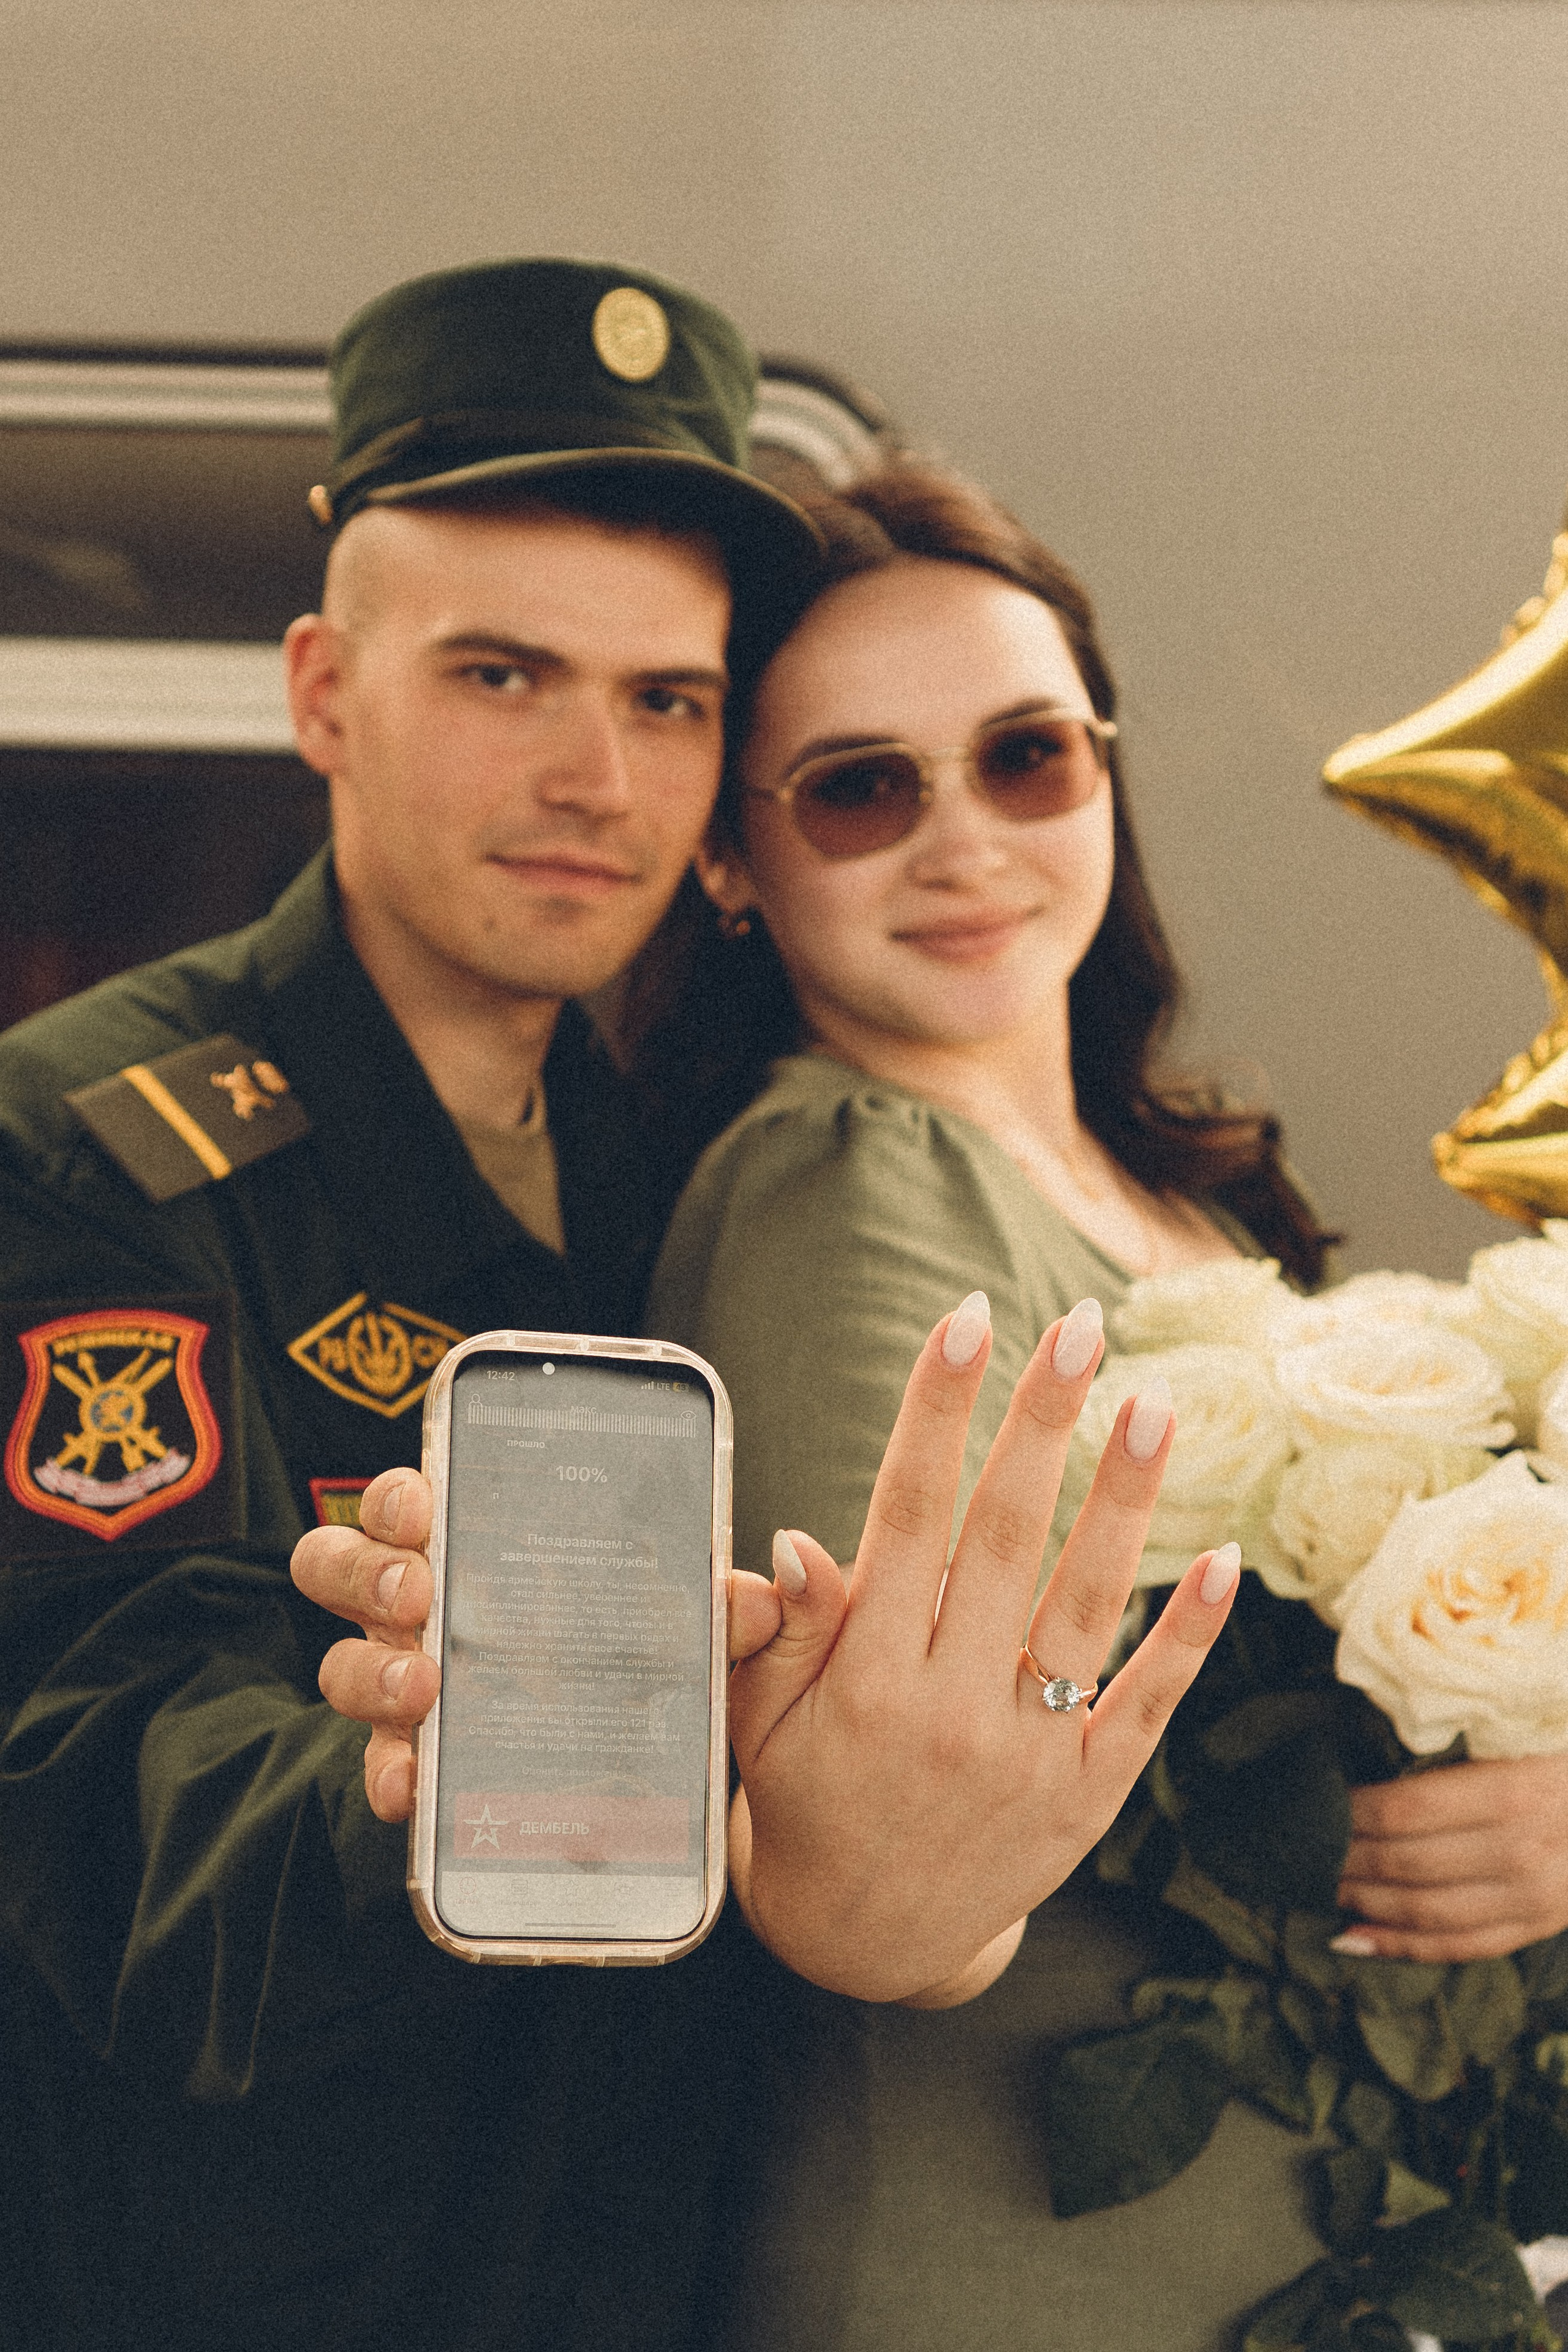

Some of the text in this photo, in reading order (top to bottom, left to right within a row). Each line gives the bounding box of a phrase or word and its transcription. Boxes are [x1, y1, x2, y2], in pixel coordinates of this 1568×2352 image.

[487, 1370, 515, 1381] 12:42
[657, 1382, 670, 1391] LTE
[507, 1439, 545, 1449] прошло
[556, 1465, 608, 1483] 100%
[527, 1534, 633, 1550] Поздравляем с
[500, 1551, 658, 1570] завершением службы!
[466, 1573, 505, 1585] Пройдя
[508, 1575, 567, 1588] армейскую
[584, 1594, 638, 1604] увереннее
[674, 1610, 692, 1618] все
[534, 1616, 575, 1627] нужные
[577, 1618, 595, 1628] для
[625, 1620, 656, 1629] чтобы
[518, 1629, 551, 1637] жизни
[554, 1630, 589, 1639] шагать
[600, 1632, 638, 1643] первых
[641, 1634, 669, 1645] рядах
[545, 1643, 586, 1653] хранить
[615, 1646, 658, 1655] счастье!
[479, 1651, 549, 1664] Поздравляем
[560, 1656, 623, 1666] окончанием
[625, 1658, 665, 1669] службы
[468, 1664, 508, 1675] желаем
[511, 1665, 557, 1677] большой
[559, 1668, 592, 1678] любви
[604, 1671, 634, 1681] удачи
[645, 1672, 684, 1683] мирной
[559, 1681, 595, 1691] жизни!
[491, 1700, 660, 1716] За время использования нашего
[481, 1714, 545, 1726] приложения
[565, 1717, 608, 1728] открыли
[611, 1719, 627, 1728] его
[630, 1718, 646, 1728] 121
[469, 1725, 516, 1738] Спасибо,
[519, 1728, 537, 1736] что
[540, 1727, 567, 1738] были
[619, 1732, 658, 1741] желаем
[495, 1741, 535, 1750] счастья
[548, 1743, 578, 1754] удачи
[595, 1744, 654, 1755] гражданке!
[519, 1821, 590, 1836] ДЕМБЕЛЬ
